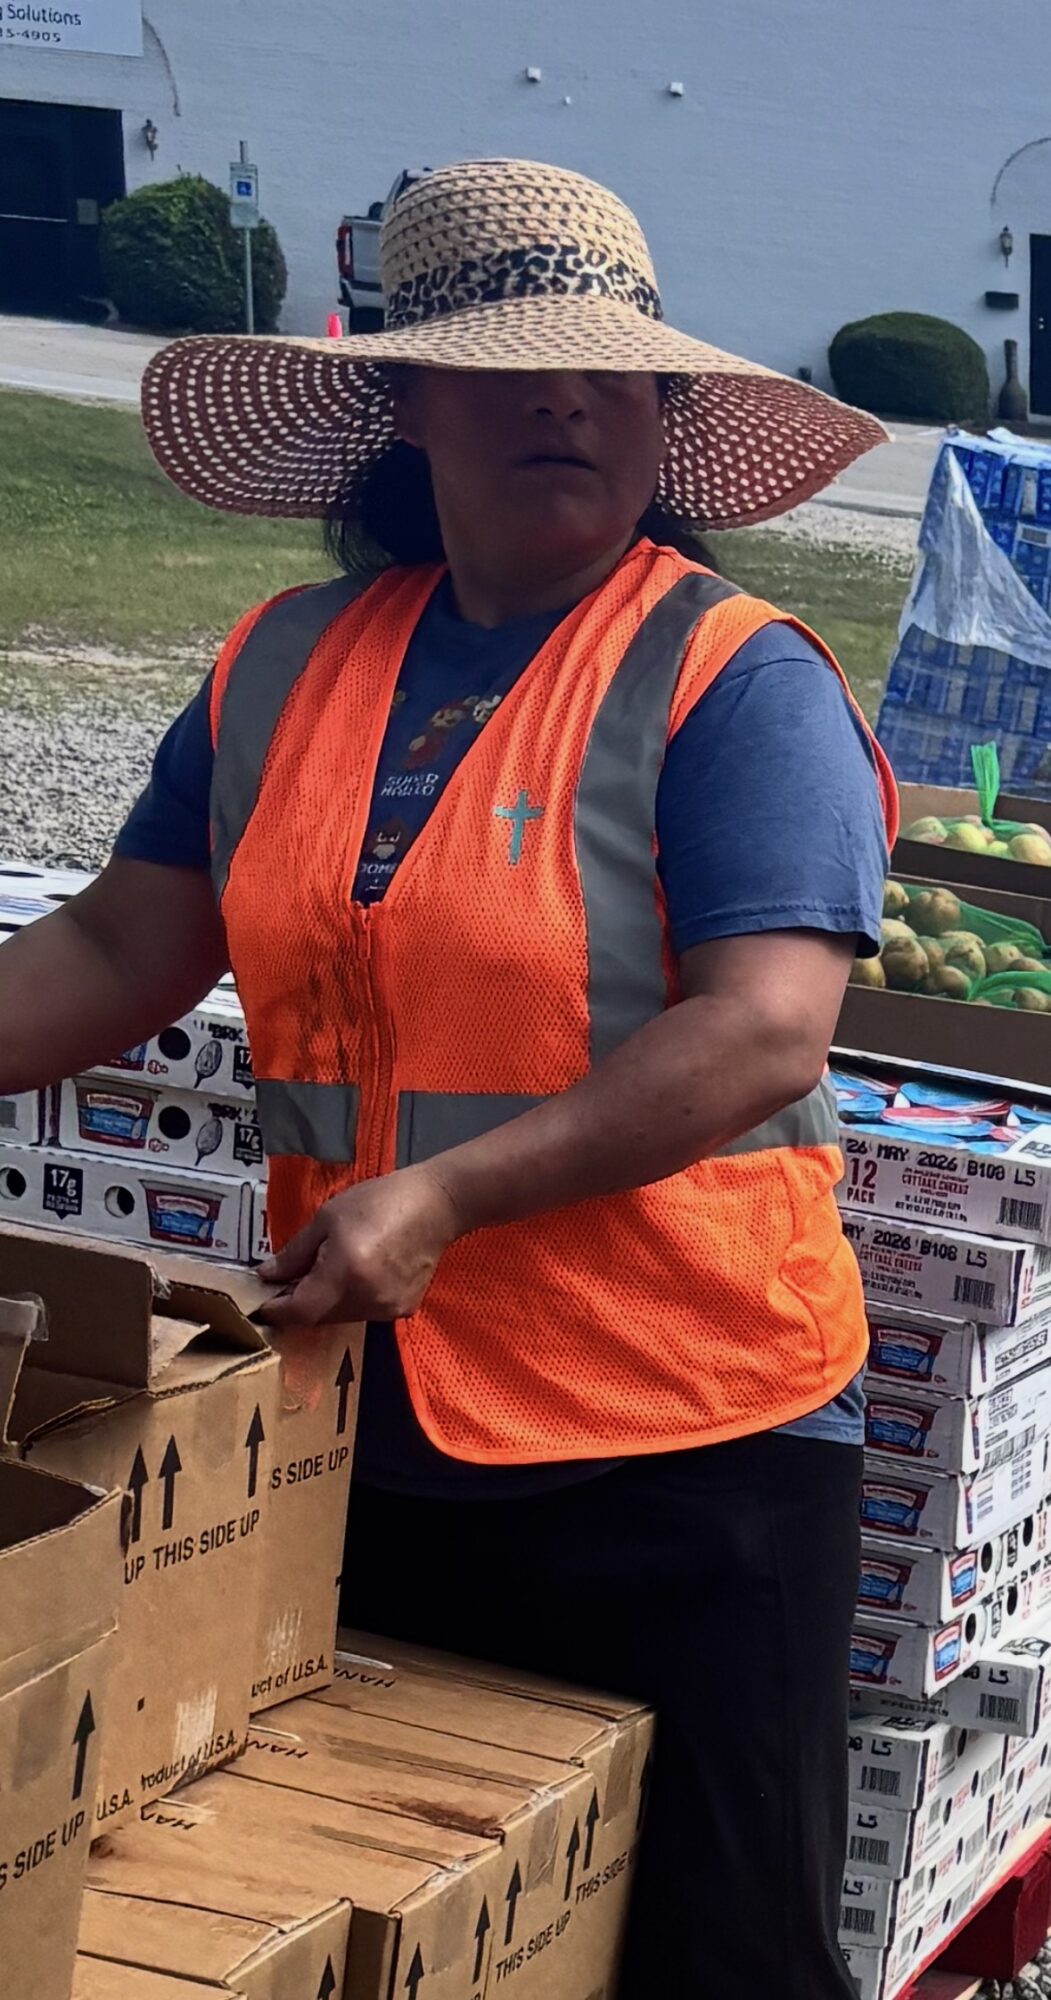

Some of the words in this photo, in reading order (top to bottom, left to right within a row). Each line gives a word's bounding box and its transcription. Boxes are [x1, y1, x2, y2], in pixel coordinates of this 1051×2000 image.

[7, 3, 82, 26] Solutions
[846, 1138, 868, 1155] 26
[917, 1151, 957, 1172] 2026
[1014, 1168, 1036, 1187] L5
[850, 1157, 878, 1189] 12
[51, 1168, 77, 1197] 17g
[847, 1187, 875, 1204] PACK
[872, 1229, 912, 1252] 2026
[966, 1248, 987, 1268] L5
[286, 1453, 324, 1485] SIDE
[328, 1446, 349, 1471] UP
[152, 1536, 194, 1570] THIS
[199, 1519, 236, 1555] SIDE
[239, 1509, 260, 1537] UP
[124, 1555, 145, 1584] UP
[275, 1666, 291, 1688] of
[12, 1828, 57, 1879] SIDE
[61, 1810, 85, 1846] UP
[576, 1872, 601, 1905] THIS
[495, 1946, 525, 1984] THIS
[525, 1923, 555, 1961] SIDE
[555, 1909, 571, 1937] UP
